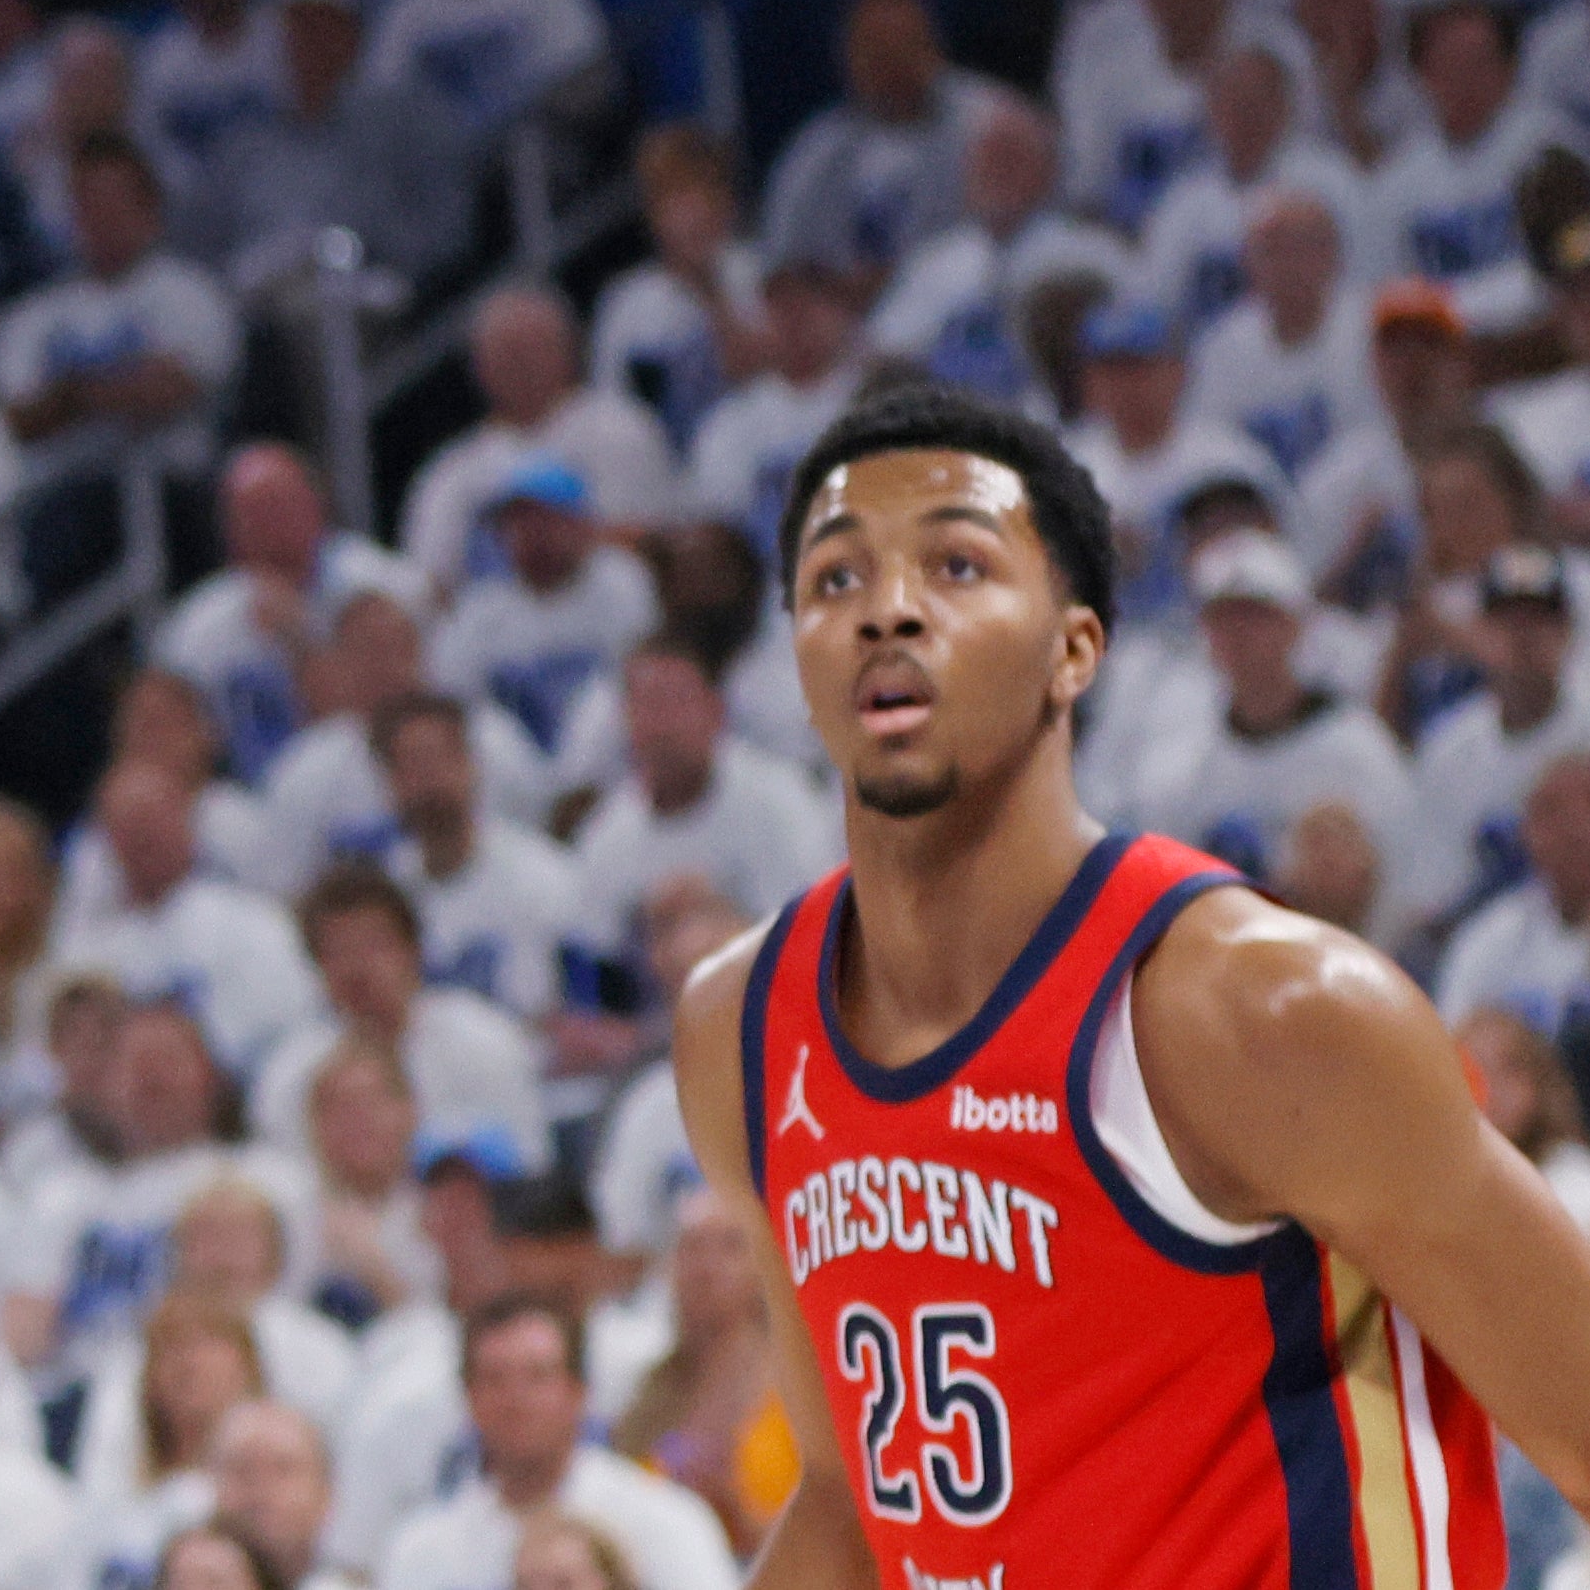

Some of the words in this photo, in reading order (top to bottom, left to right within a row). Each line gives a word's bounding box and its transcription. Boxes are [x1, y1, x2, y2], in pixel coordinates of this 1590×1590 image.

[950, 1084, 1058, 1135] ibotta
[785, 1156, 1060, 1288] CRESCENT
[837, 1301, 1013, 1528] 25
